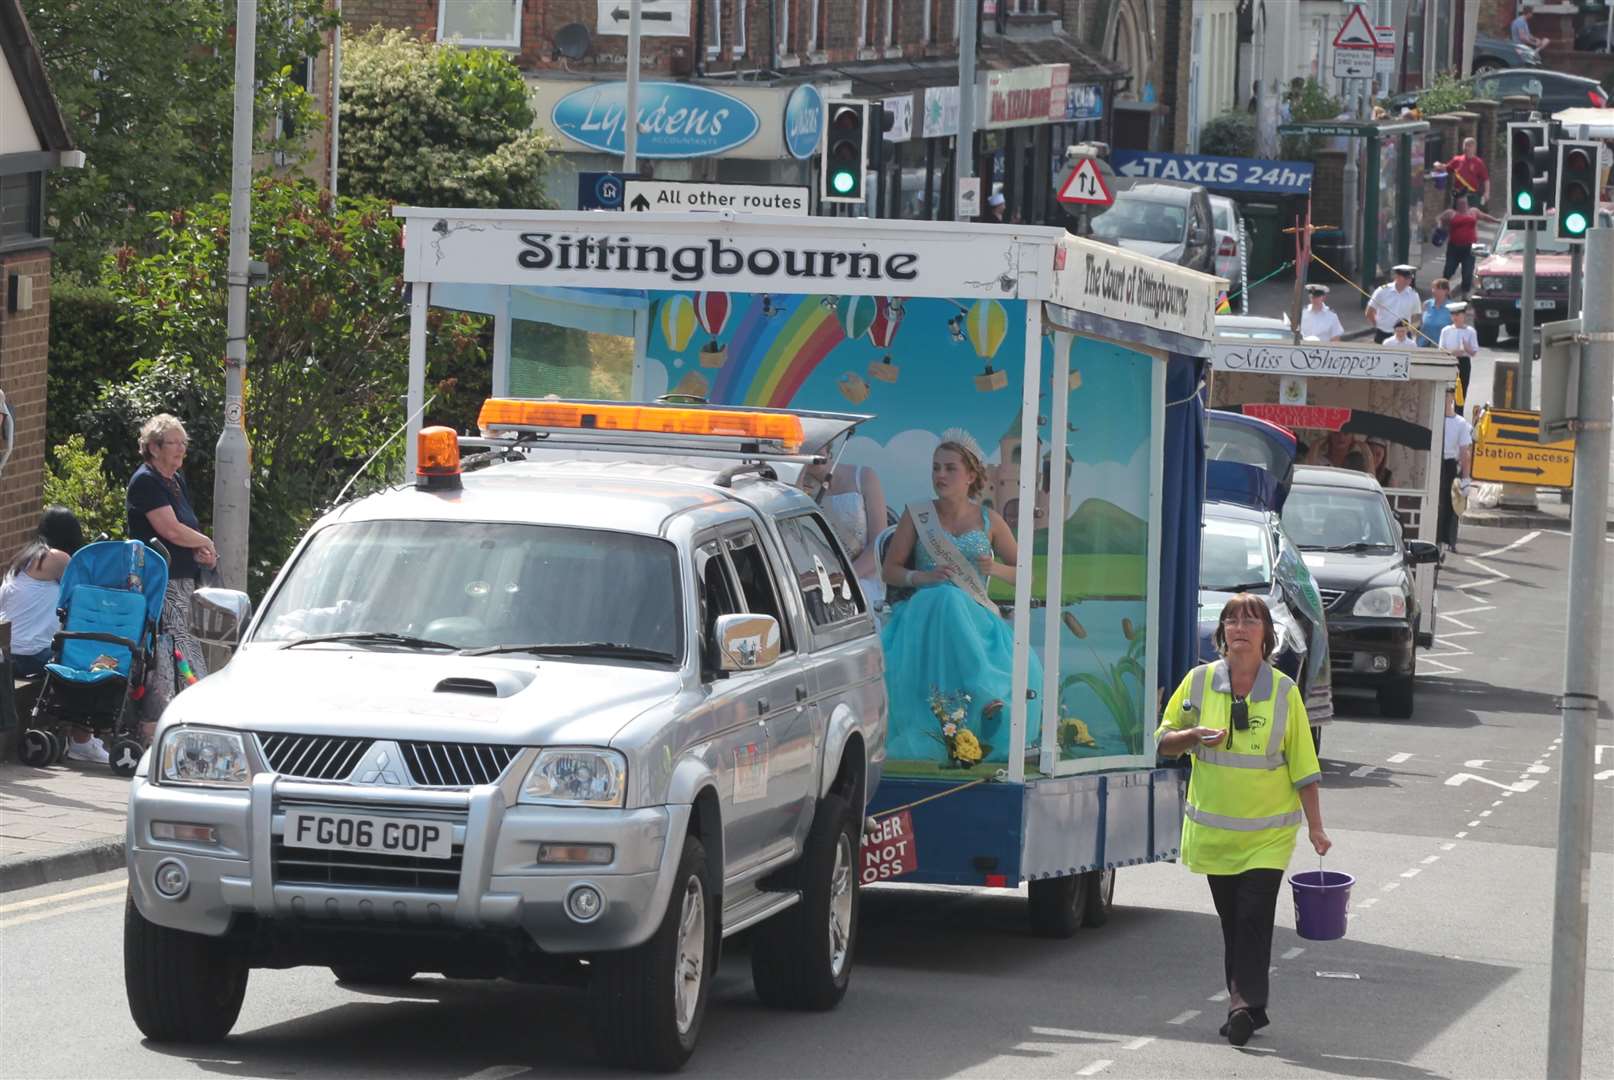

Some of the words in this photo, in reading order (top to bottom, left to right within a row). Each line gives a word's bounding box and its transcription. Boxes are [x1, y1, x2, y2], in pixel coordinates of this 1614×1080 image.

[1143, 157, 1238, 183] TAXIS
[1244, 166, 1313, 187] 24hr
[656, 189, 681, 205] All
[687, 191, 736, 206] other
[743, 195, 802, 209] routes
[516, 231, 919, 283] Sittingbourne
[1084, 252, 1102, 297] The
[1102, 257, 1126, 303] Court
[1126, 265, 1137, 305] of
[1137, 267, 1189, 319] Sittingbourne
[1224, 348, 1283, 370] Miss
[1289, 348, 1382, 376] Sheppey
[1253, 405, 1343, 420] HOGWARTS
[1475, 446, 1523, 460] Station
[1526, 452, 1570, 464] access
[297, 814, 374, 848] FG06
[382, 821, 441, 853] GOP
[866, 840, 908, 867] NOT
[860, 859, 903, 884] OSS
